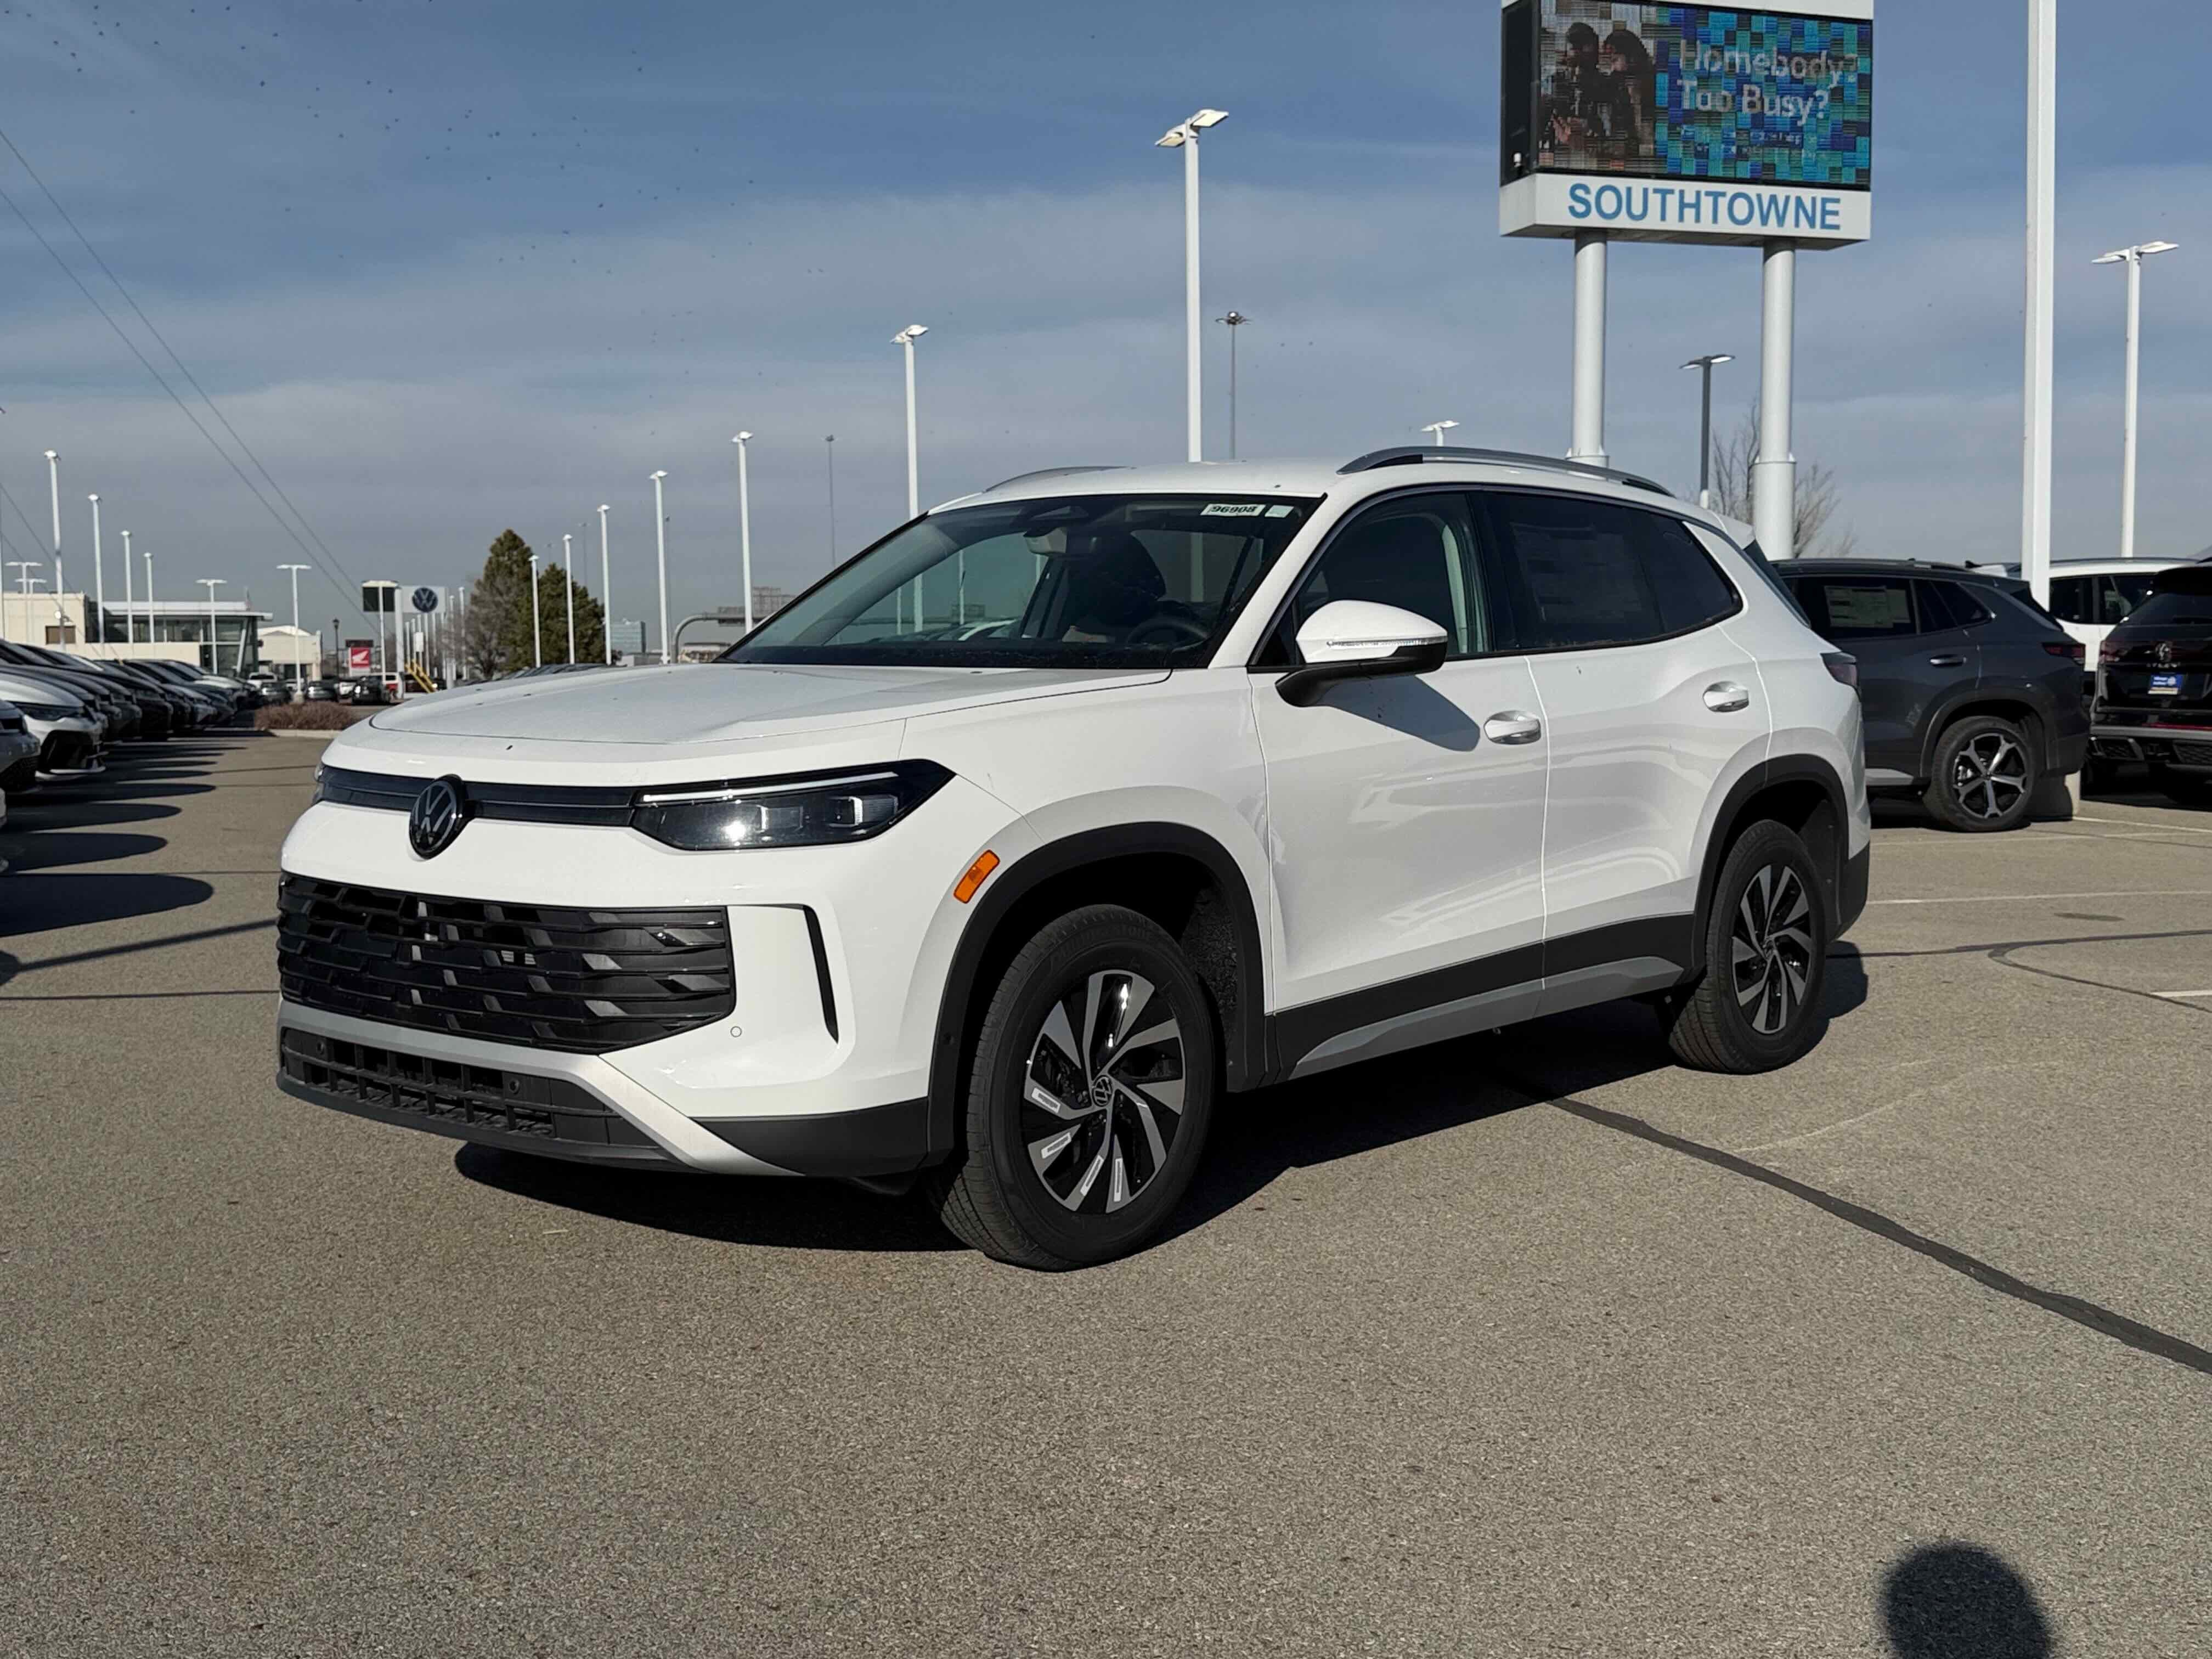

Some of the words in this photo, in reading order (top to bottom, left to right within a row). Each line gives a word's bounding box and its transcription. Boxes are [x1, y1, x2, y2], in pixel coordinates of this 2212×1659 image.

[1679, 40, 1858, 88] Homebody?
[1677, 79, 1733, 112] Too
[1742, 83, 1830, 127] Busy?
[1568, 183, 1841, 230] SOUTHTOWNE
